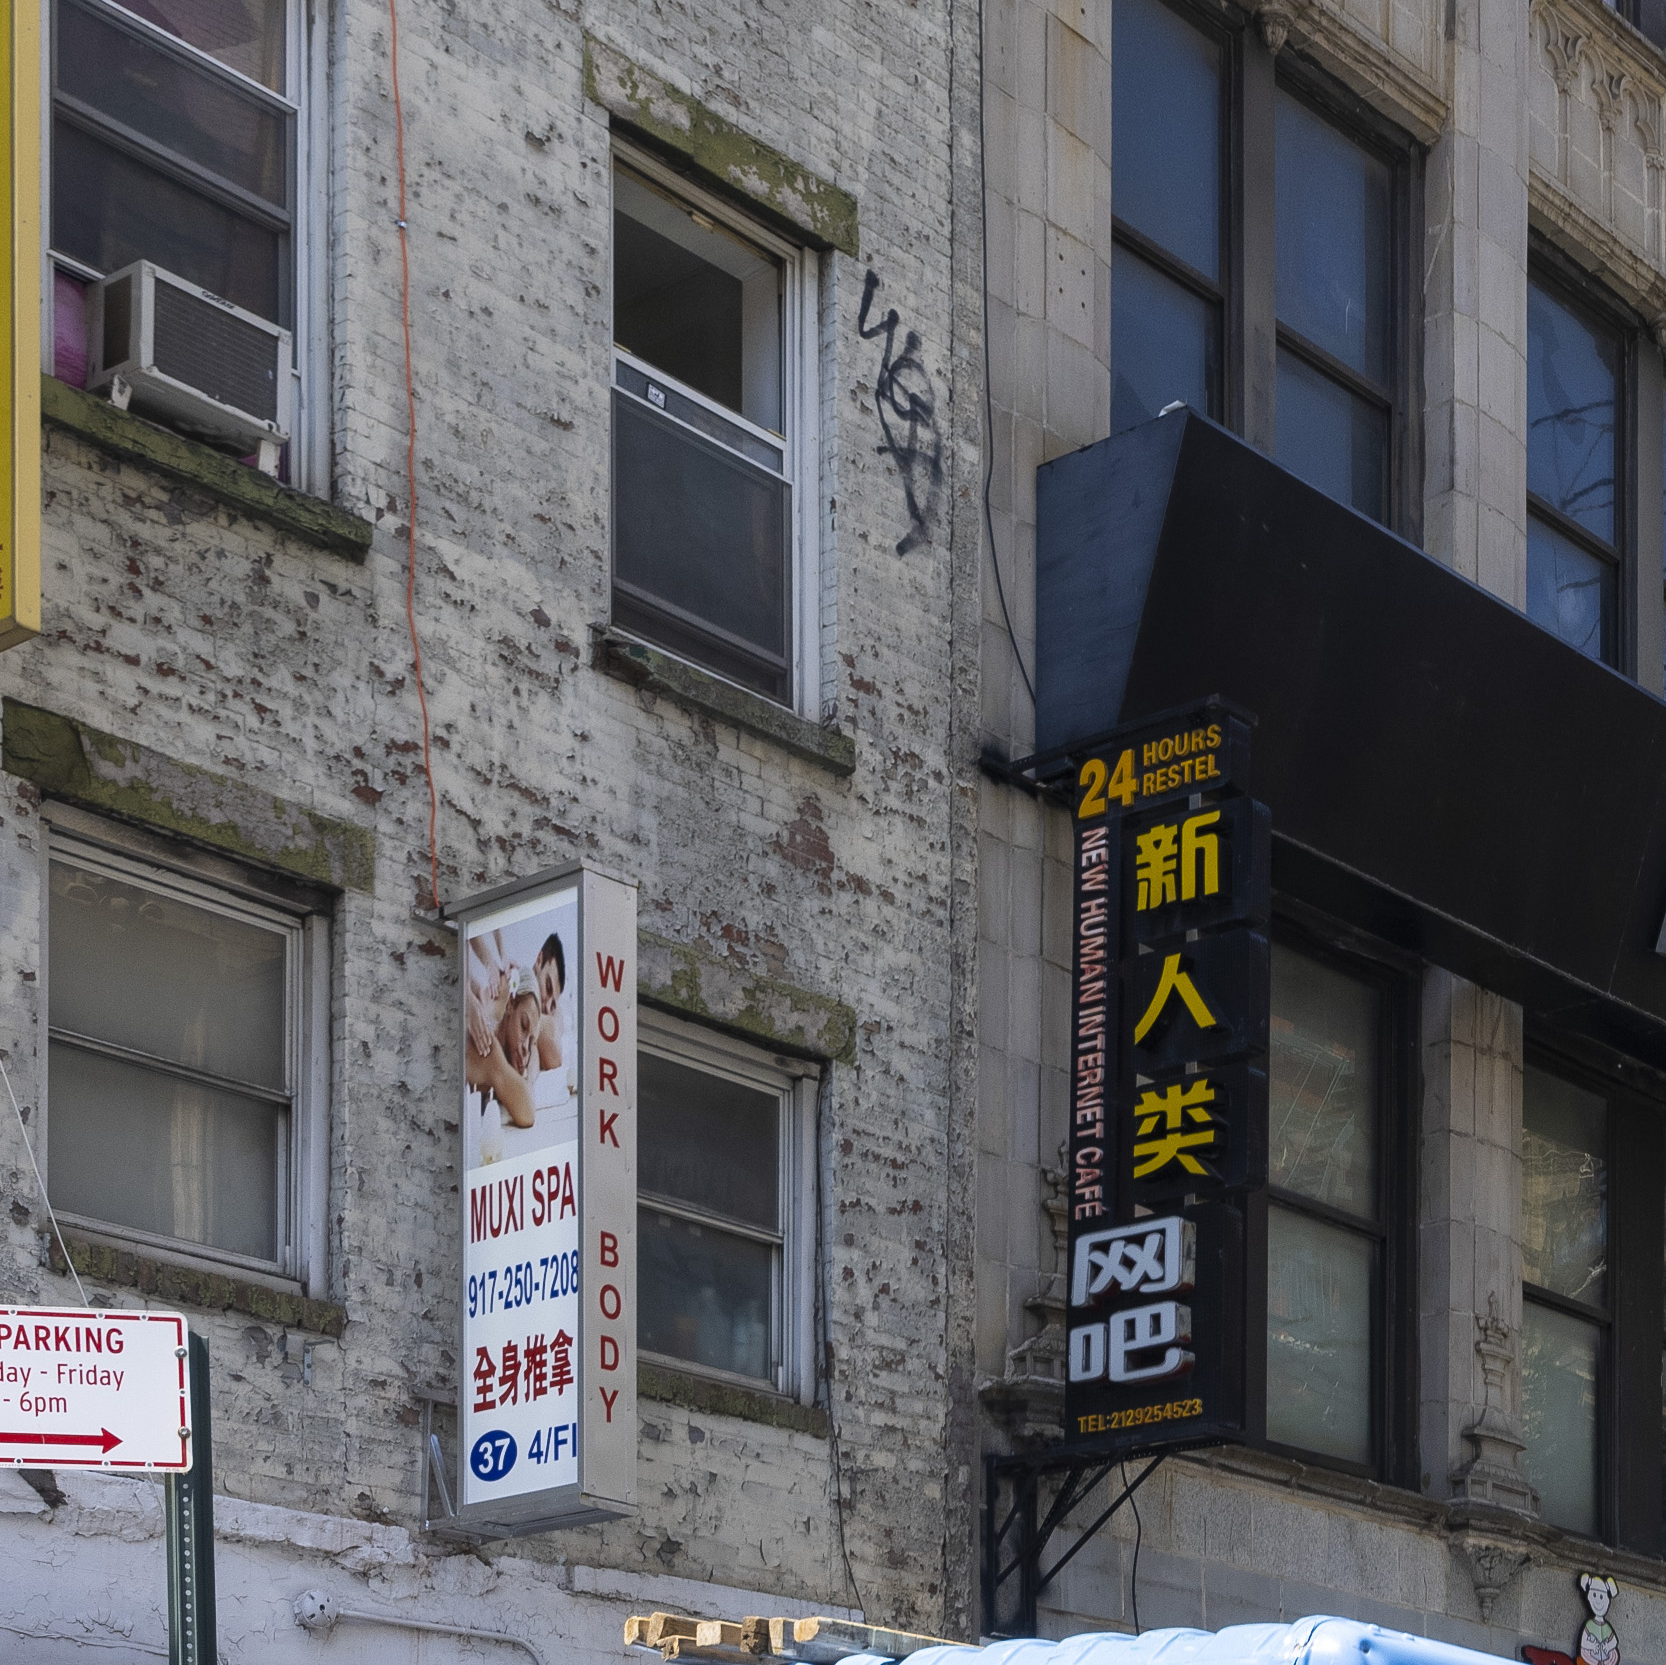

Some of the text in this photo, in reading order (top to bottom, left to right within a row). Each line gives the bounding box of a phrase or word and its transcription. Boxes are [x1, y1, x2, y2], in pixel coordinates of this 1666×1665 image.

[1078, 724, 1222, 819] 24 HOURS
[1143, 754, 1221, 796] RESTEL
[1081, 826, 1109, 891] NEW
[1080, 897, 1108, 1003] HUMAN
[1077, 1005, 1106, 1138] INTERNET
[470, 1161, 577, 1243] MUXI SPA
[595, 951, 625, 1424] WORK BODY
[468, 1249, 579, 1318] 917-250-7208
[0, 1324, 124, 1354] PARKING
[473, 1329, 575, 1413] 全身推拿
[20, 1391, 68, 1417] 6pm
[57, 1363, 124, 1391] Friday
[1077, 1398, 1203, 1434] TEL:2129254523
[478, 1438, 511, 1474] 37
